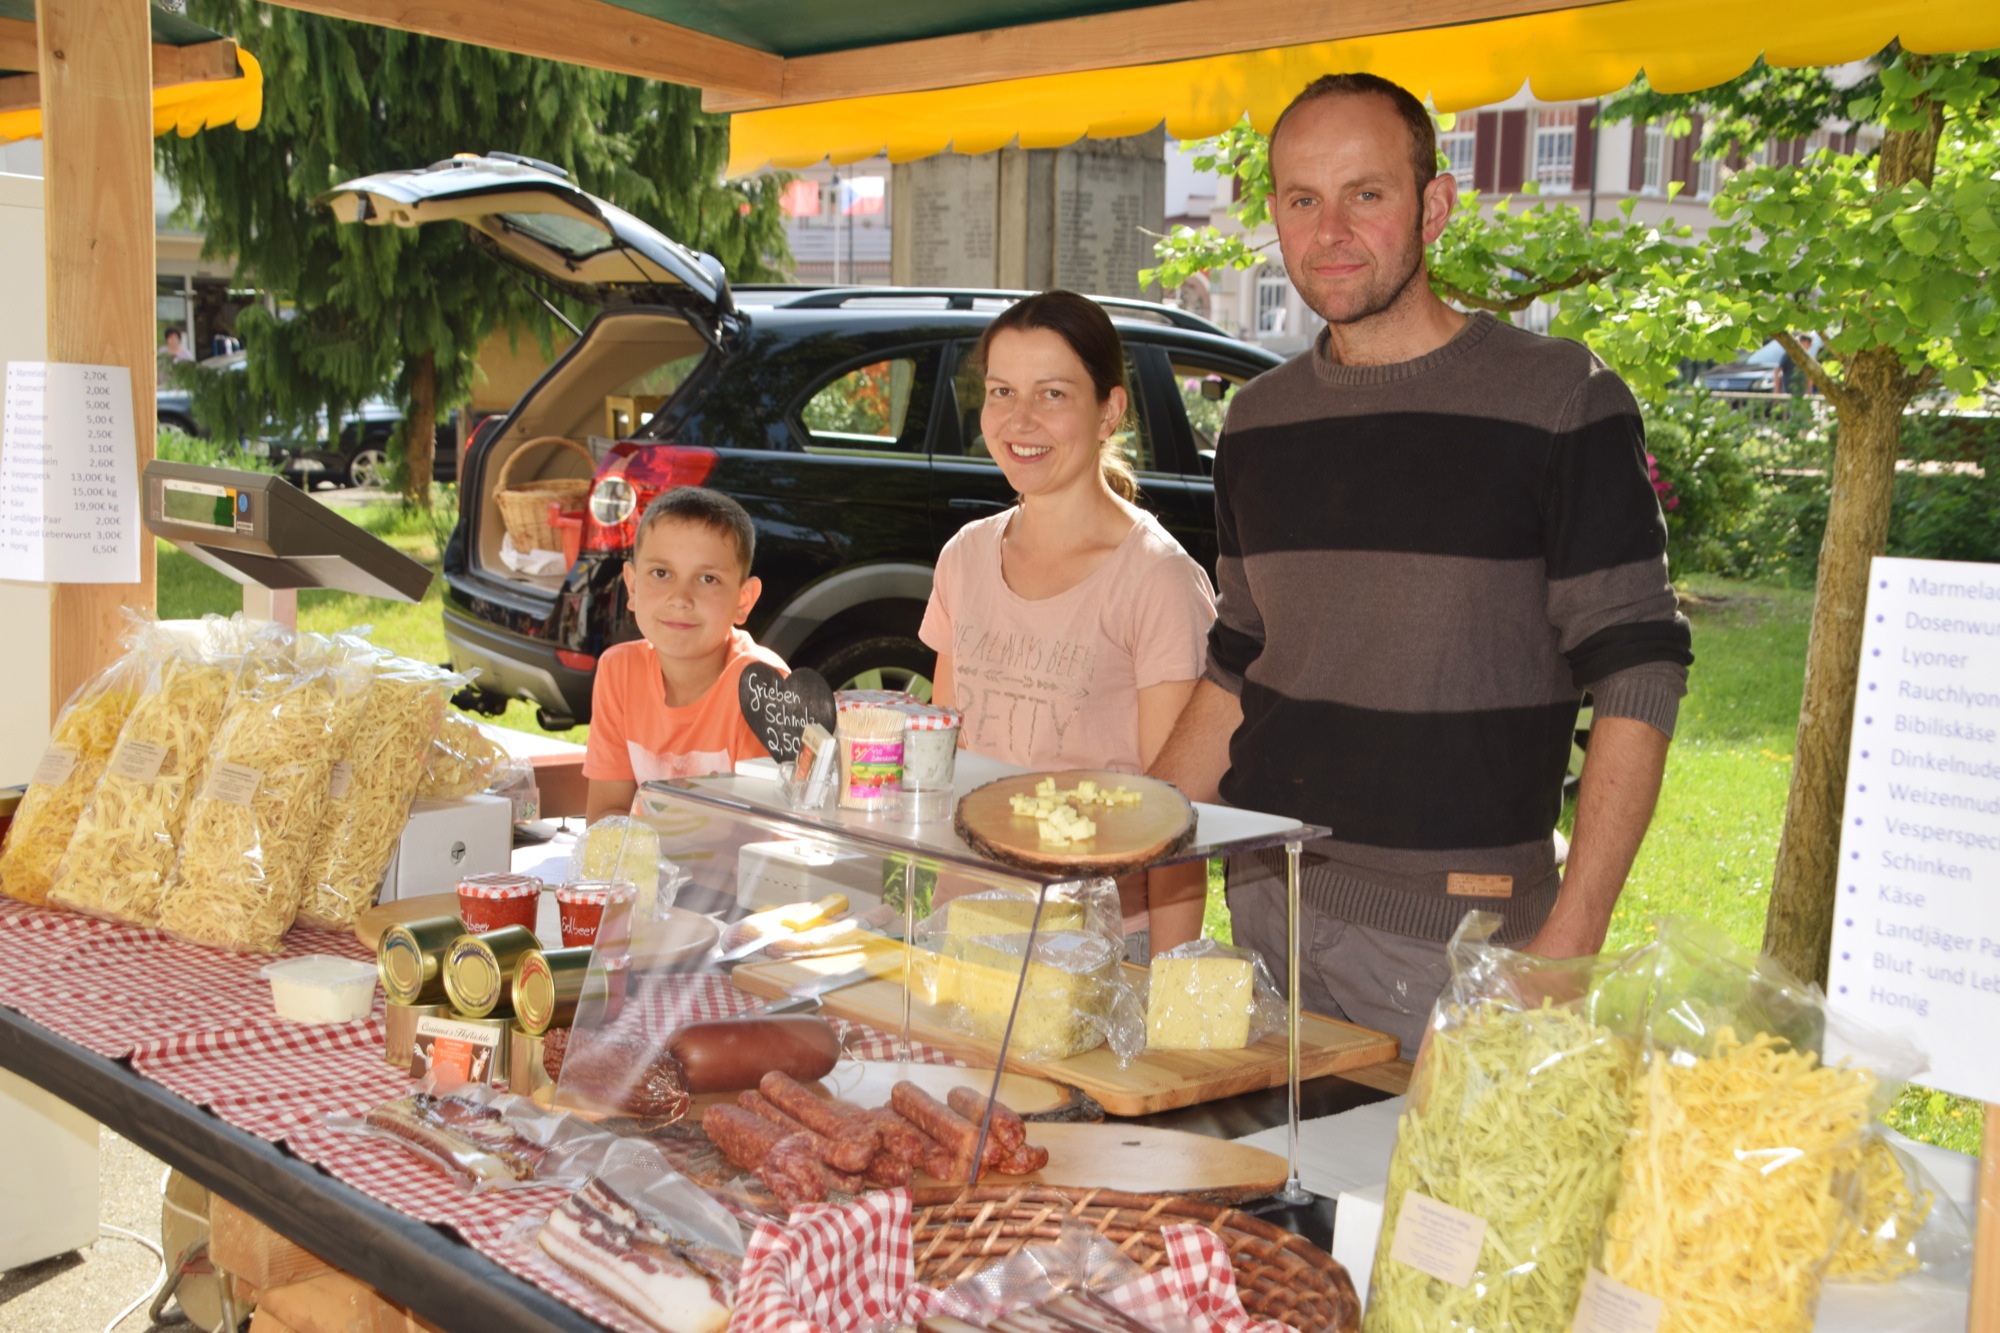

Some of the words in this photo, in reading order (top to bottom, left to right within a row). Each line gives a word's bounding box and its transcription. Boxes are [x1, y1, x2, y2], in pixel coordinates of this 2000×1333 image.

[84, 371, 108, 381] 2,70€
[86, 386, 111, 396] 2,00€
[86, 401, 111, 410] 5,00€
[87, 415, 107, 425] 5,00
[88, 430, 113, 439] 2,50€
[89, 444, 115, 454] 3,10€
[90, 459, 115, 469] 2,60€
[71, 473, 103, 482] 13,00€
[105, 474, 116, 484] kg
[73, 488, 105, 497] 15,00€
[107, 488, 118, 498] kg
[75, 502, 107, 512] 19,90€
[108, 502, 120, 512] kg
[43, 515, 61, 524] Paar
[96, 516, 122, 526] 2,00€
[42, 530, 92, 540] Leberwurst
[97, 531, 122, 541] 3,00€
[93, 545, 118, 554] 6,50€
[1902, 646, 1968, 670] Lyoner
[749, 673, 801, 712] Grieben
[1898, 680, 2000, 708] Rauchlyon
[1894, 714, 1997, 744] Bibiliskäse
[1881, 850, 1972, 882] Schinken
[1878, 885, 1926, 908] Käse
[1875, 918, 1973, 952] Landjäger
[1873, 951, 1913, 975] Blut
[1920, 965, 1966, 986] -und
[1869, 985, 1929, 1017] Honig
